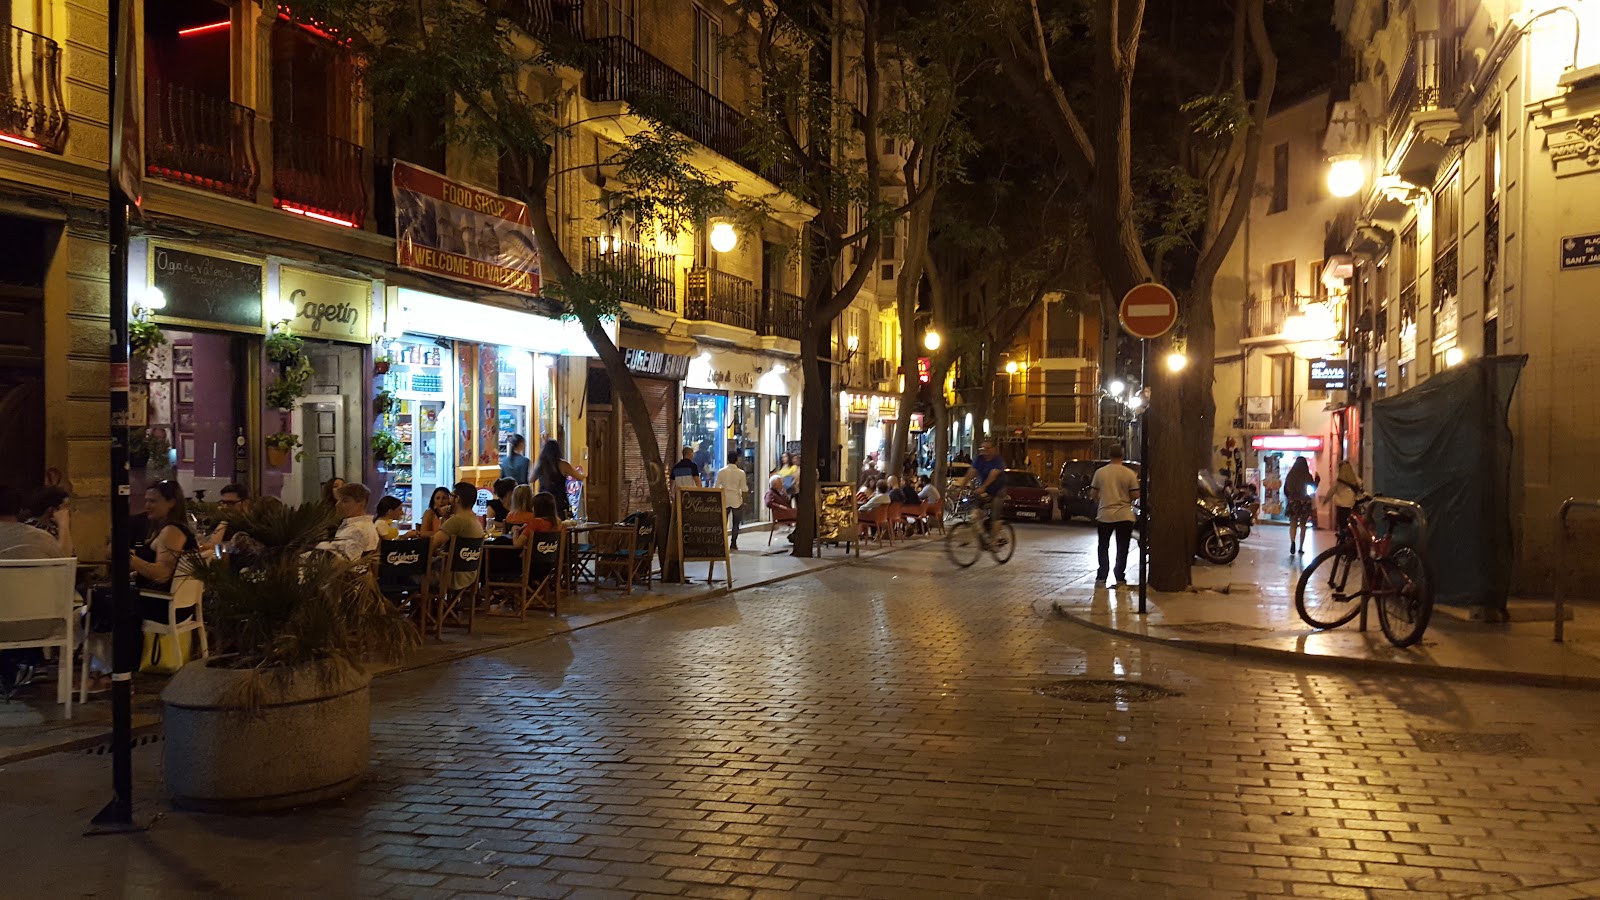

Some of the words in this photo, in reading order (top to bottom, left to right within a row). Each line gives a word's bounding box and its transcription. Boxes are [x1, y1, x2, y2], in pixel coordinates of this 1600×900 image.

[442, 182, 472, 209] FOOD
[474, 193, 505, 217] SHOP
[1585, 246, 1595, 254] DE
[414, 246, 470, 276] WELCOME
[471, 261, 485, 279] TO
[487, 265, 533, 290] VALENCIA
[1565, 255, 1587, 265] SANT
[624, 348, 664, 374] EUGENIO
[692, 502, 722, 513] Valencia
[386, 550, 420, 566] Carlsberg
